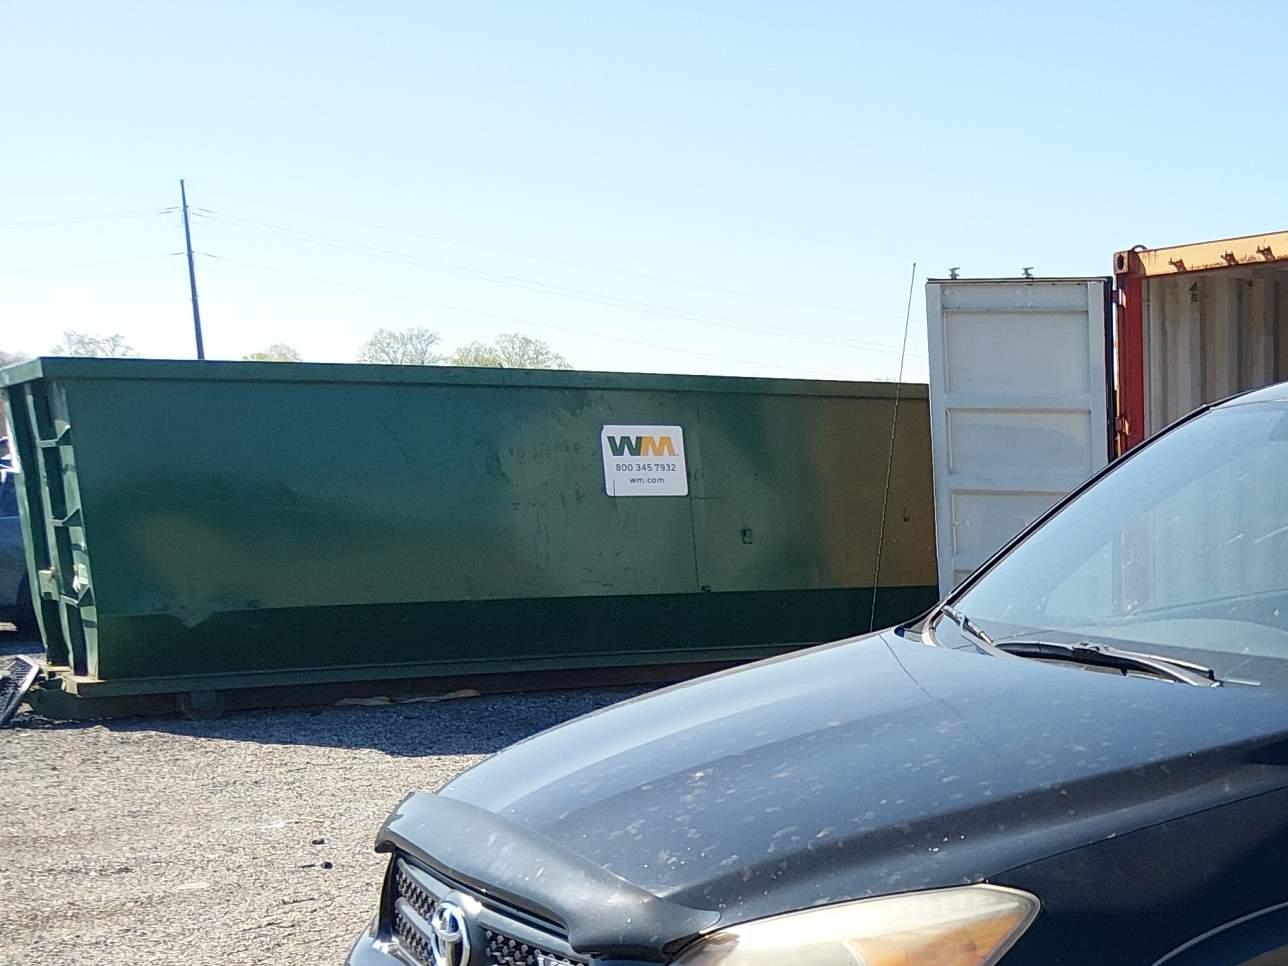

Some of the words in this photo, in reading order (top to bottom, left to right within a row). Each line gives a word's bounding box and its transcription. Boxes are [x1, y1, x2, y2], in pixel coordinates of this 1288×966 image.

[607, 436, 676, 456] WM
[615, 463, 634, 472] 800
[636, 463, 653, 472] 345
[655, 463, 677, 472] 7932
